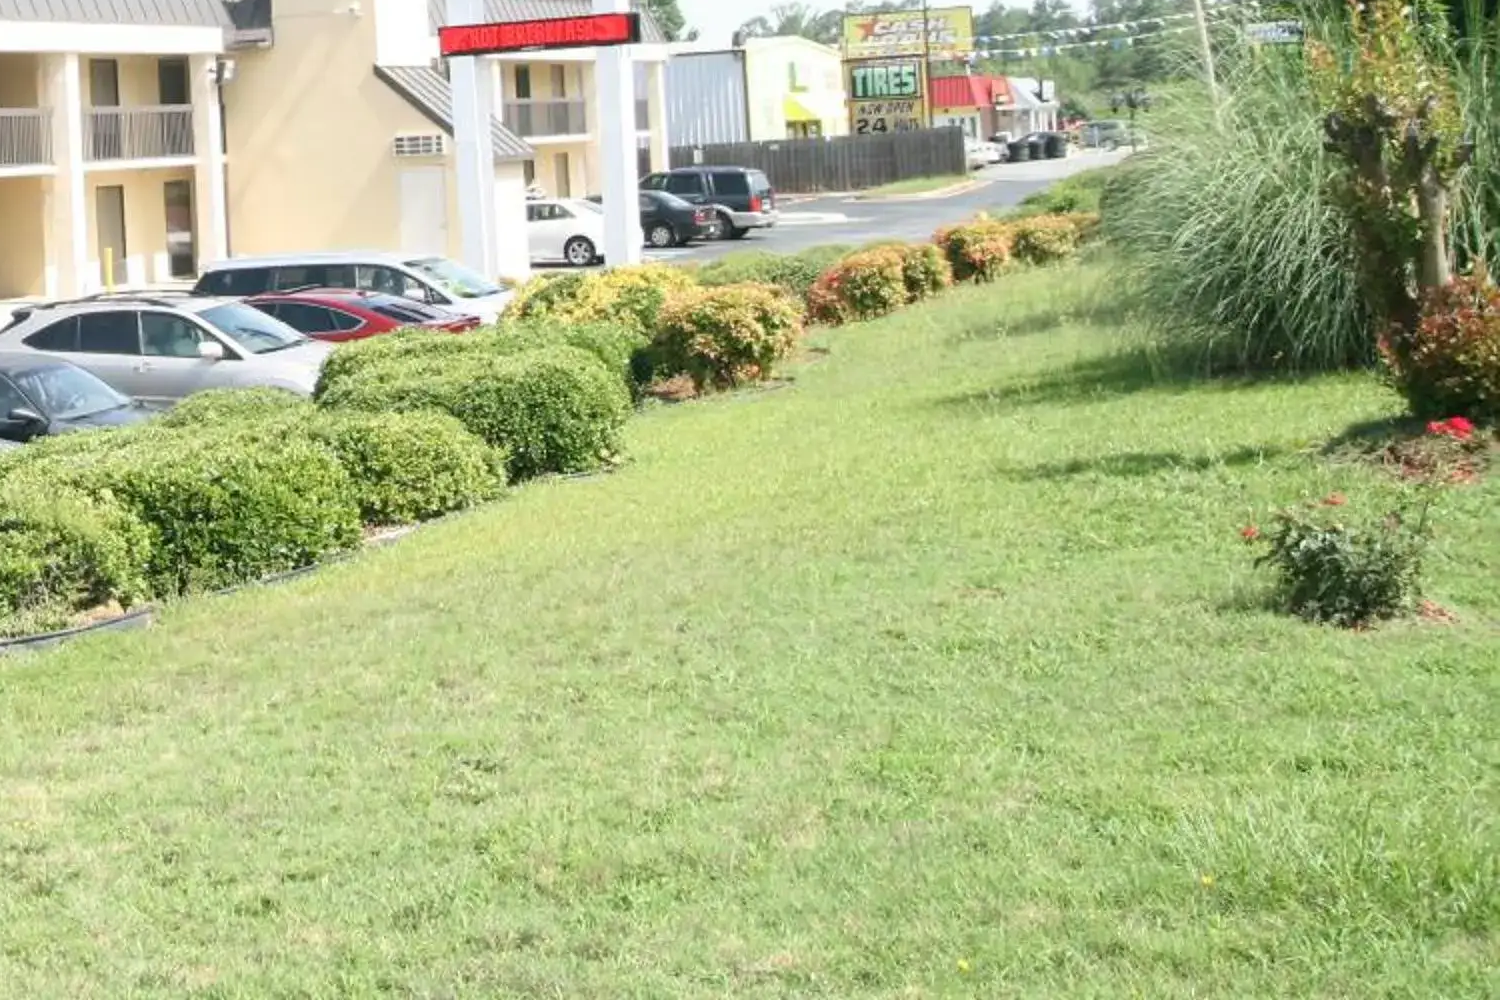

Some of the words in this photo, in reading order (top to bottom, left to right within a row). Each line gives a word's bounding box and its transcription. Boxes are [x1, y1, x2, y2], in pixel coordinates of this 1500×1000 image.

[469, 24, 498, 48] HOT
[852, 65, 916, 96] TIRES
[856, 117, 888, 135] 24
